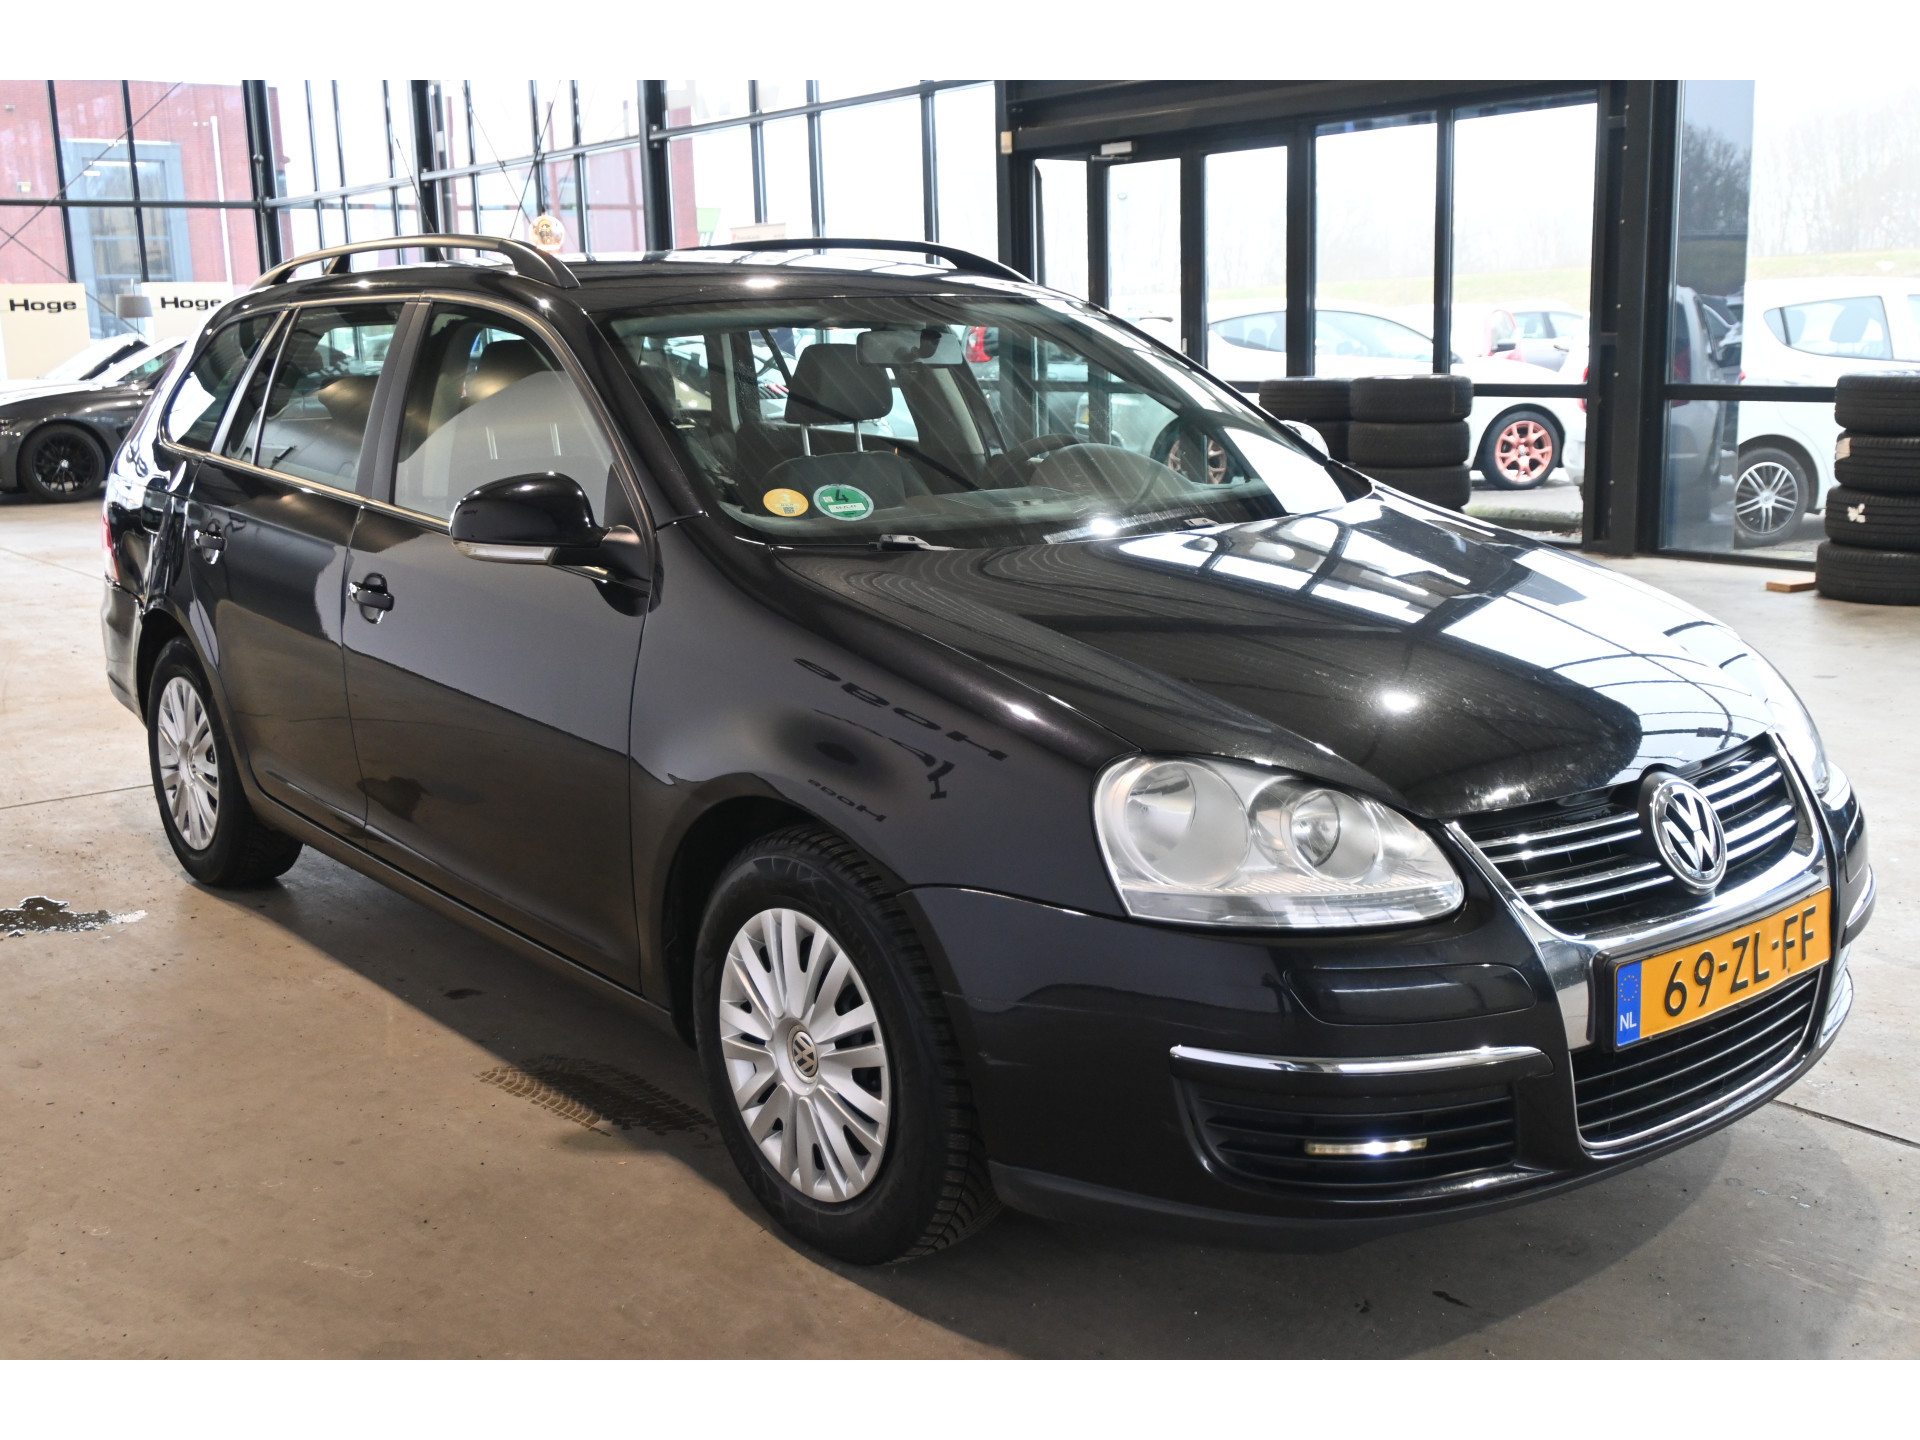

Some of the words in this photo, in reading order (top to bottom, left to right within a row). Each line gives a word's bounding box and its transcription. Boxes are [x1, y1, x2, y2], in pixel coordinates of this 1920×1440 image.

[9, 298, 77, 314] Hoge
[160, 296, 221, 311] Hoge
[836, 489, 849, 502] 4
[1656, 782, 1722, 882] VW
[1664, 905, 1817, 1017] 69-ZL-FF
[1619, 1012, 1637, 1032] NL
[791, 1031, 818, 1078] VW
